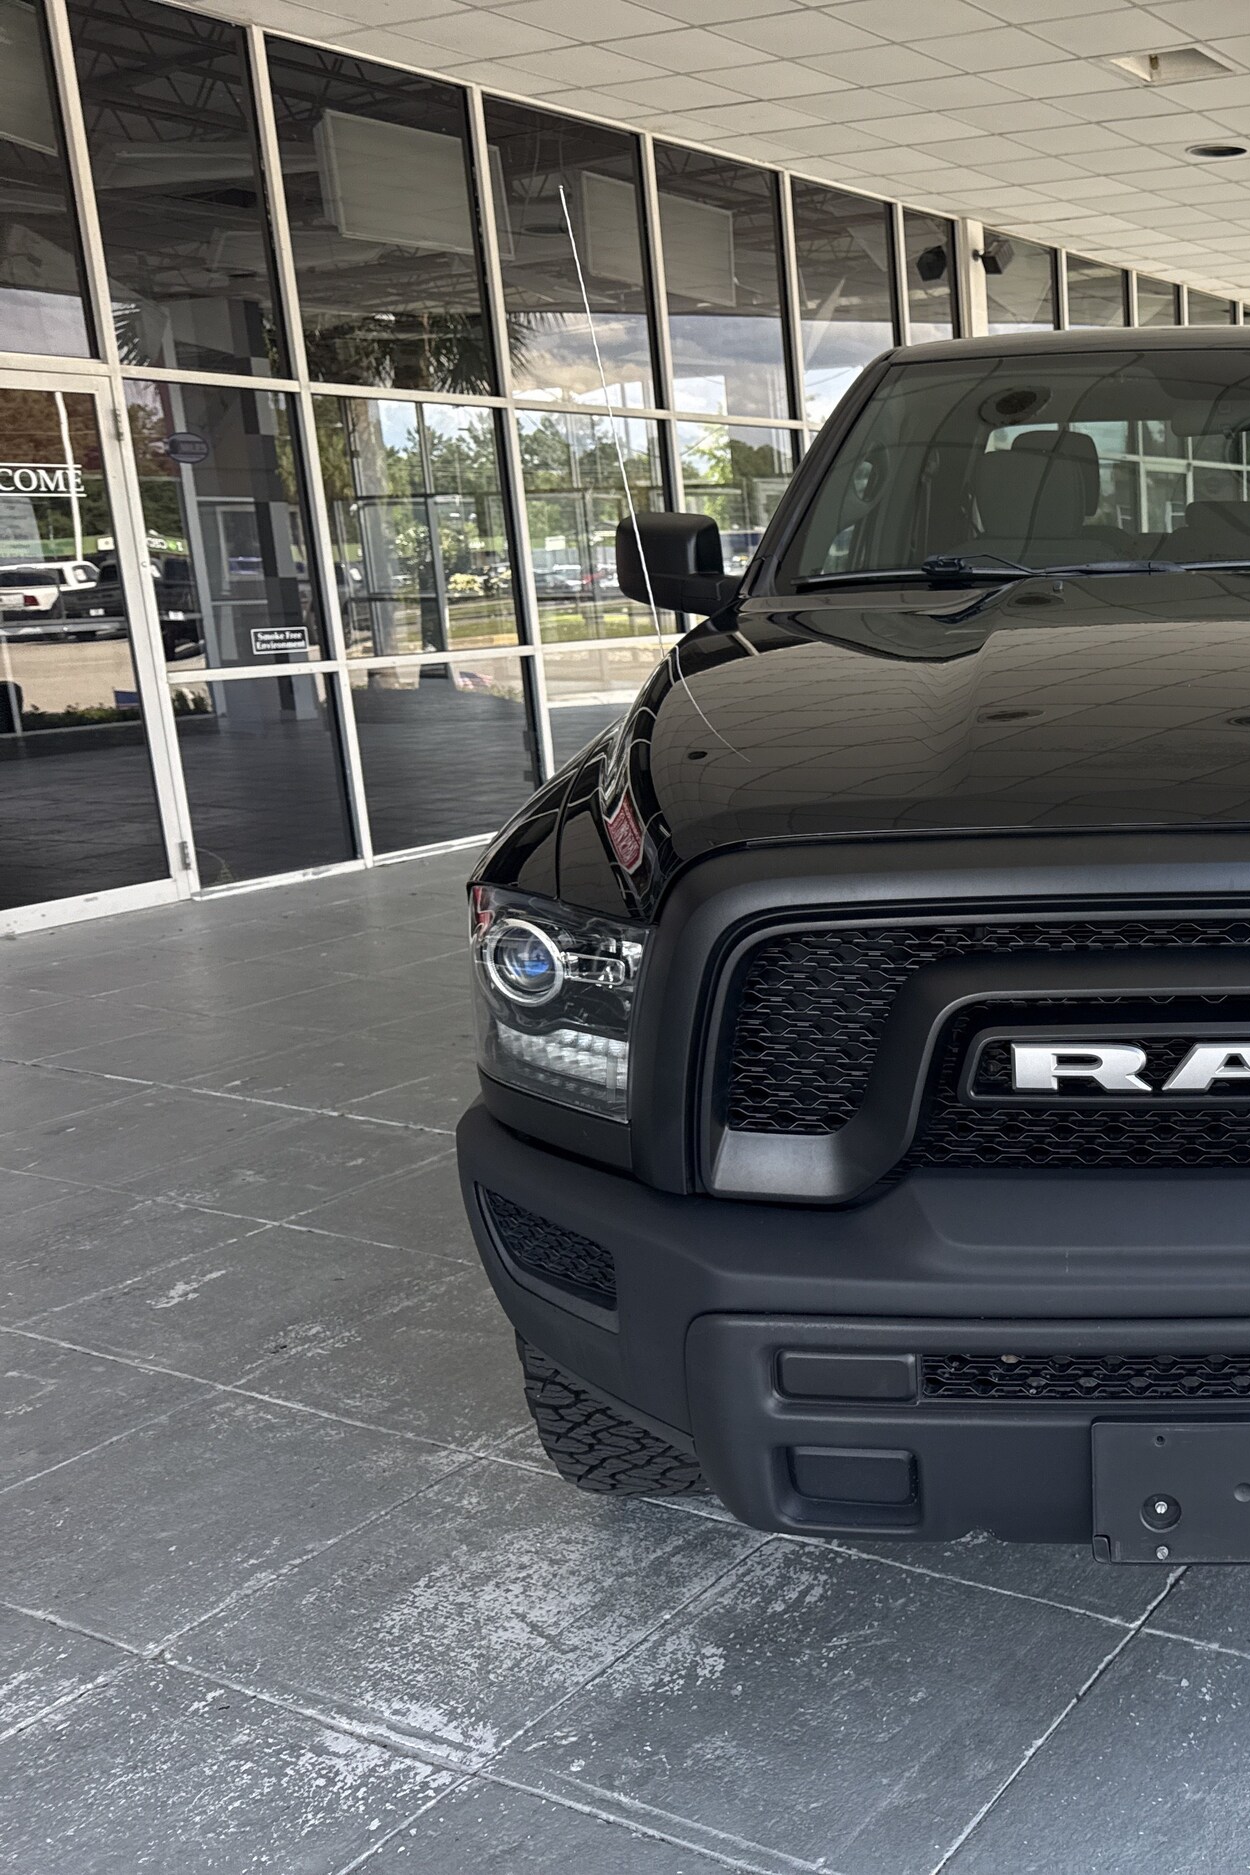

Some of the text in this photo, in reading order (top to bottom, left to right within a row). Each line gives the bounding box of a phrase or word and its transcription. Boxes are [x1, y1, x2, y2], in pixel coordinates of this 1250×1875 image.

[257, 631, 302, 640] Smoke Free
[256, 640, 305, 650] Environment
